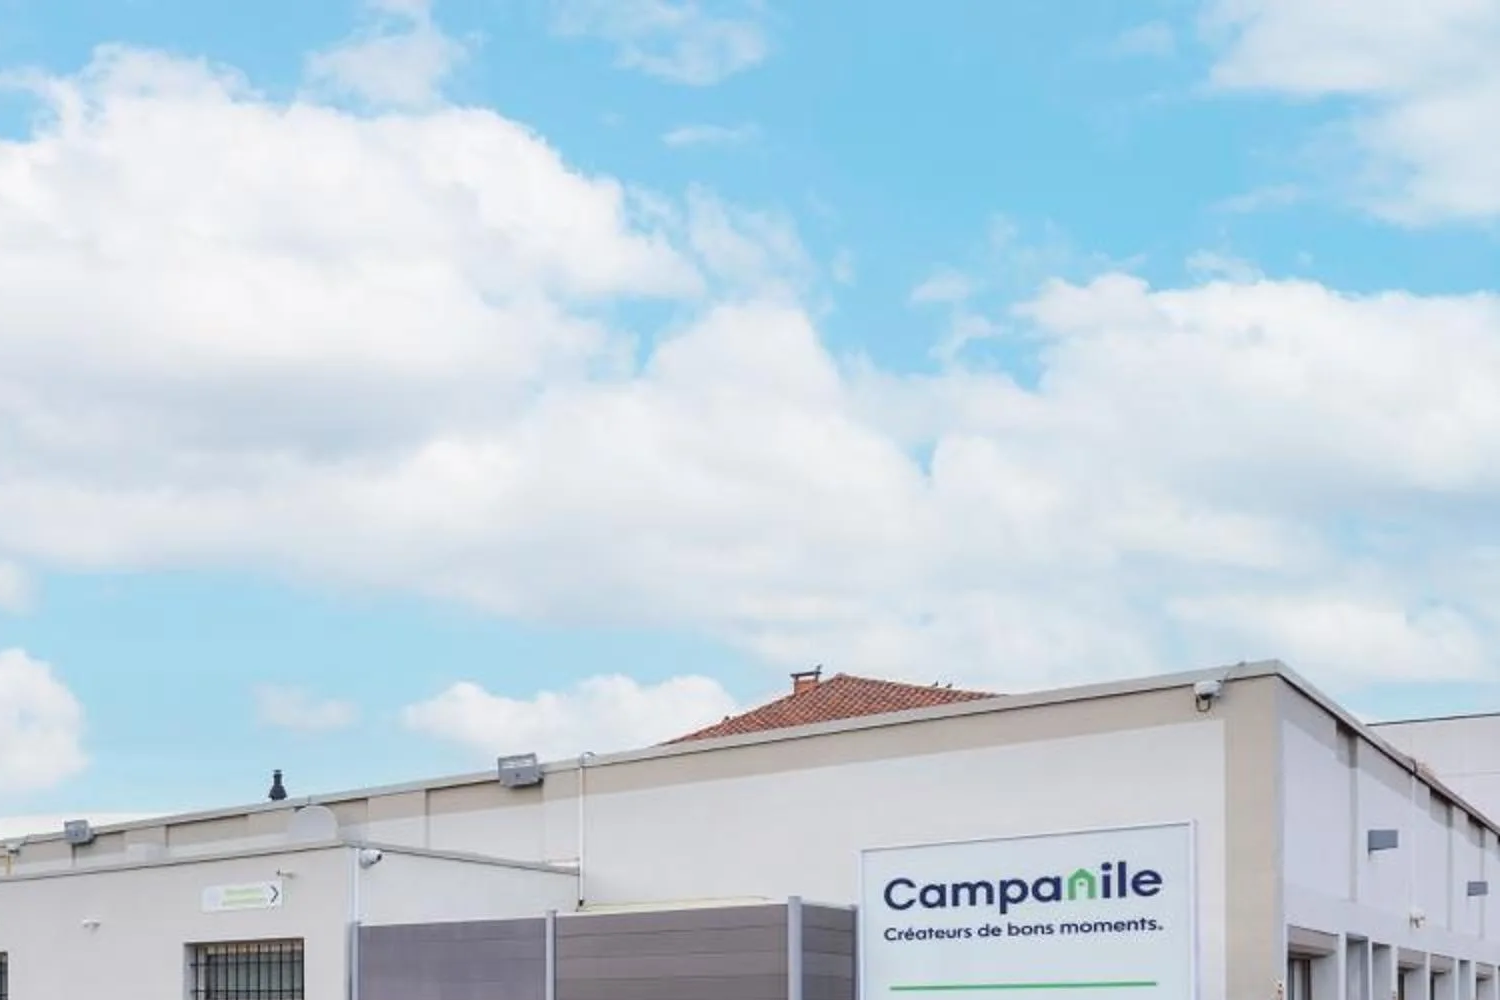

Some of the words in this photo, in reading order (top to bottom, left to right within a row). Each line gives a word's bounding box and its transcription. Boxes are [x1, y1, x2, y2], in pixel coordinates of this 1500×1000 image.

[883, 861, 1163, 915] Campanile
[883, 924, 973, 942] Créateurs
[977, 923, 1002, 938] de
[1007, 922, 1055, 937] bons
[1059, 917, 1164, 935] moments.
